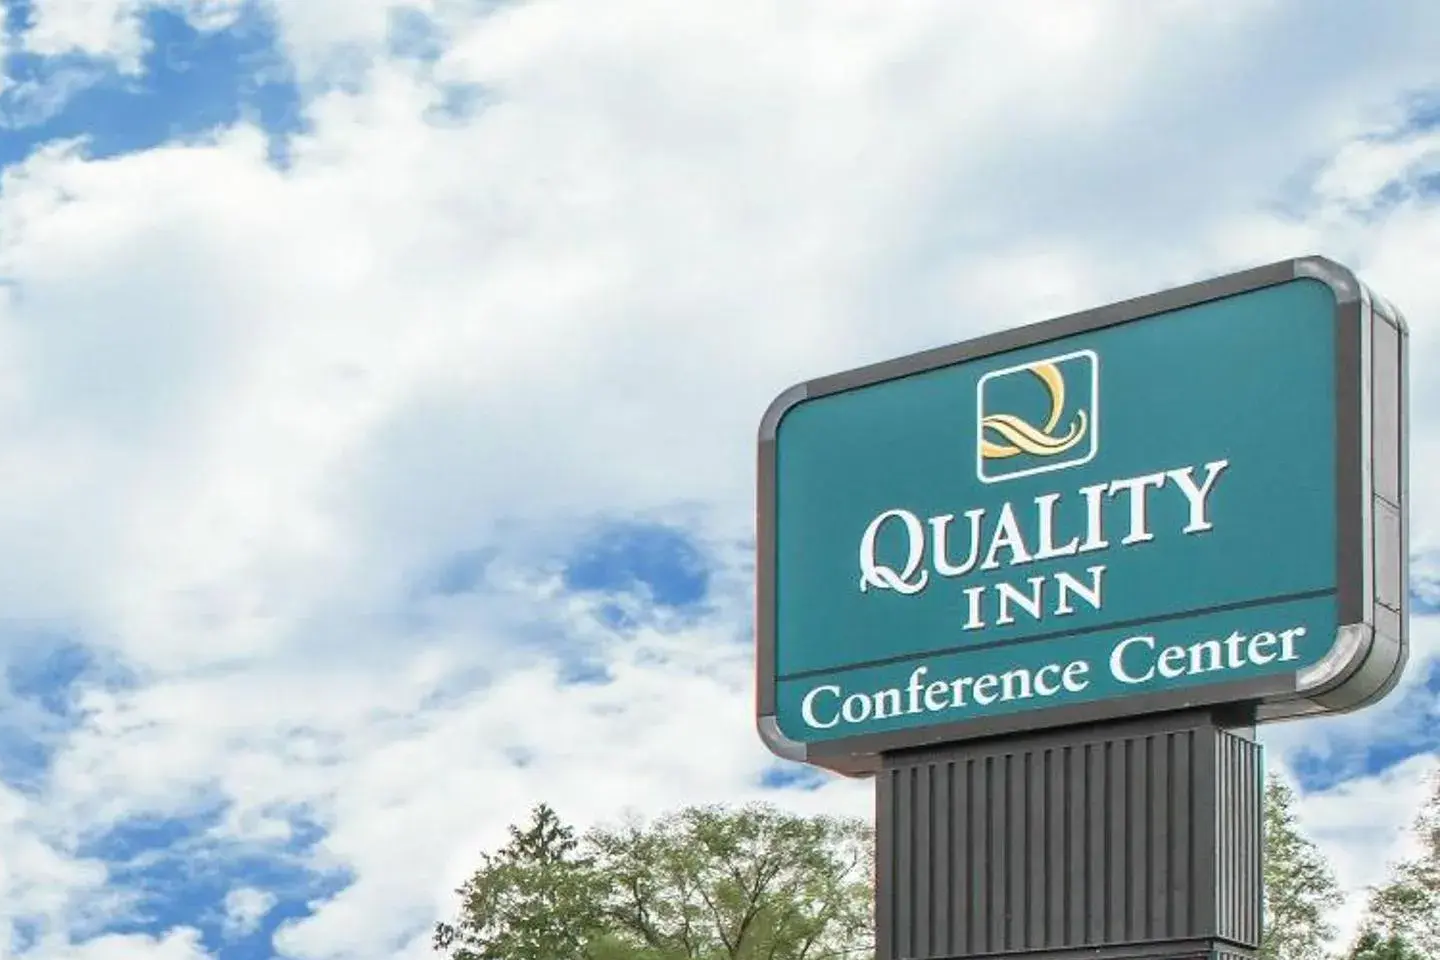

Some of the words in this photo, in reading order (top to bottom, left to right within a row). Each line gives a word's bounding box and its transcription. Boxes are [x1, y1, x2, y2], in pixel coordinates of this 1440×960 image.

[859, 459, 1228, 596] QUALITY
[962, 565, 1107, 631] INN
[801, 658, 1090, 730] Conference
[1109, 623, 1308, 686] Center
